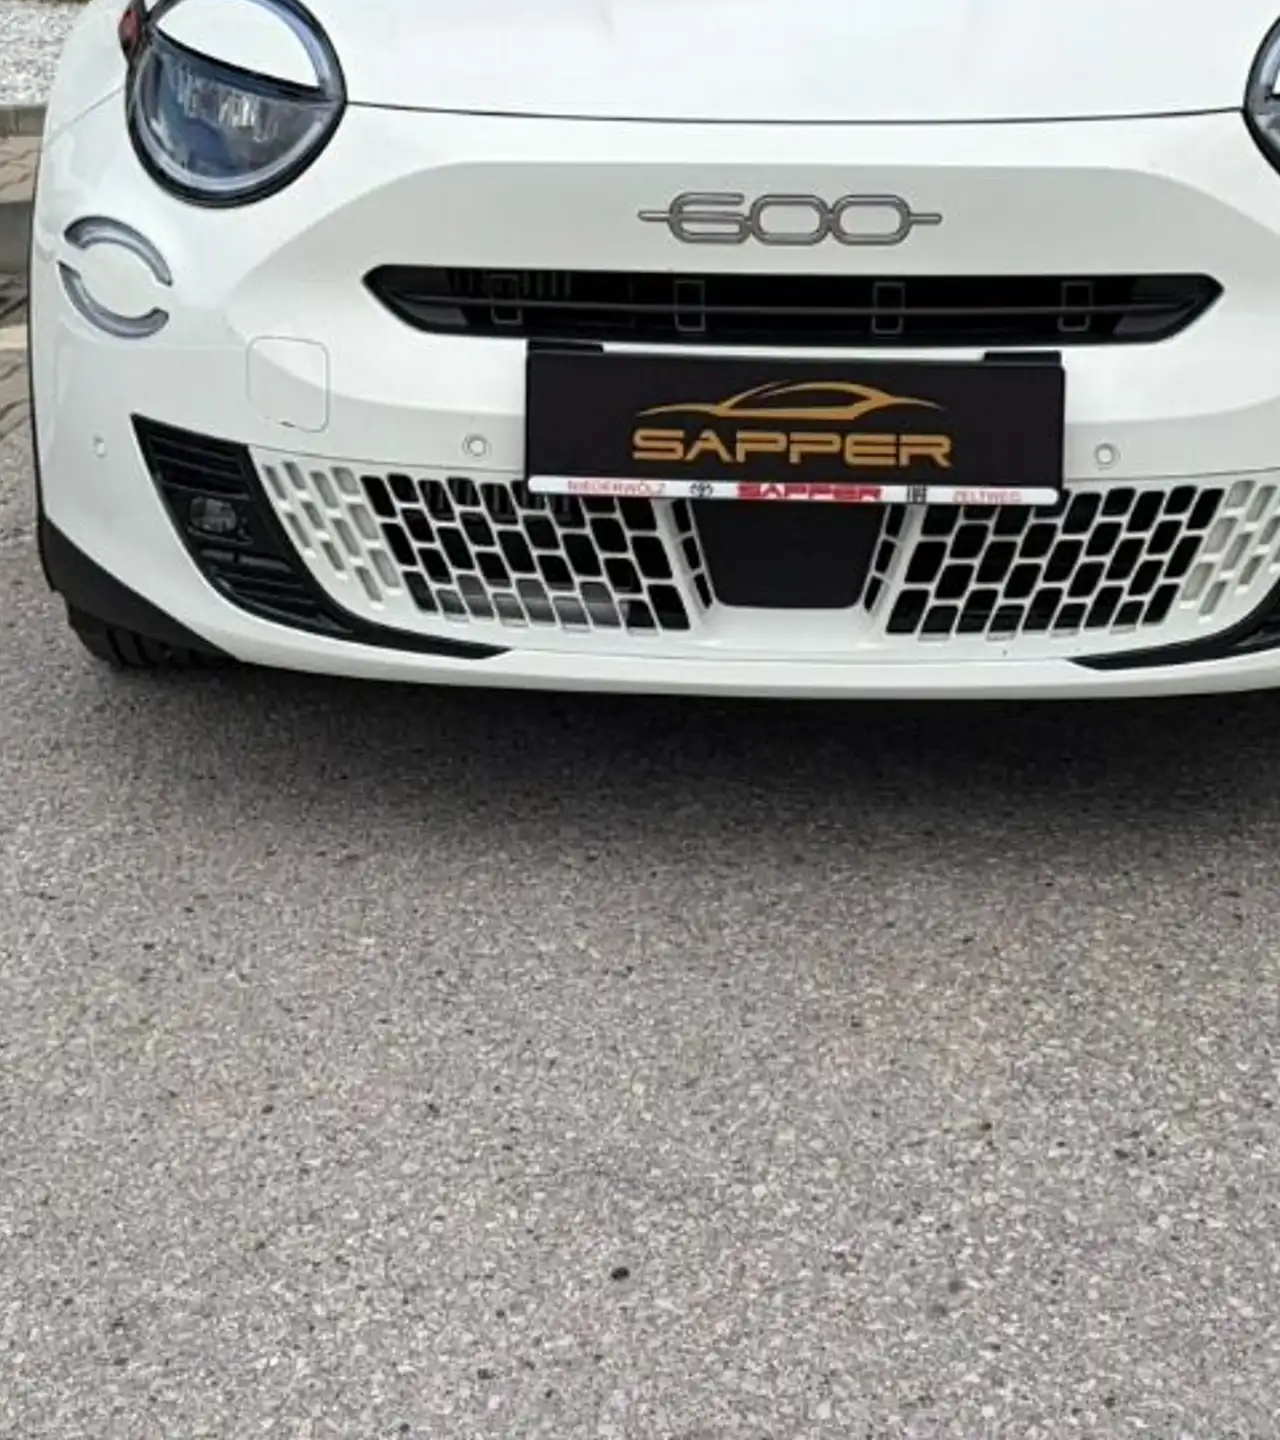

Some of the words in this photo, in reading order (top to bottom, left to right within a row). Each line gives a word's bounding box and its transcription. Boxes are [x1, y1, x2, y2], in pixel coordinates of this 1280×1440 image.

[668, 192, 913, 246] 600
[632, 428, 952, 468] SAPPER
[736, 482, 883, 502] SAPPER
